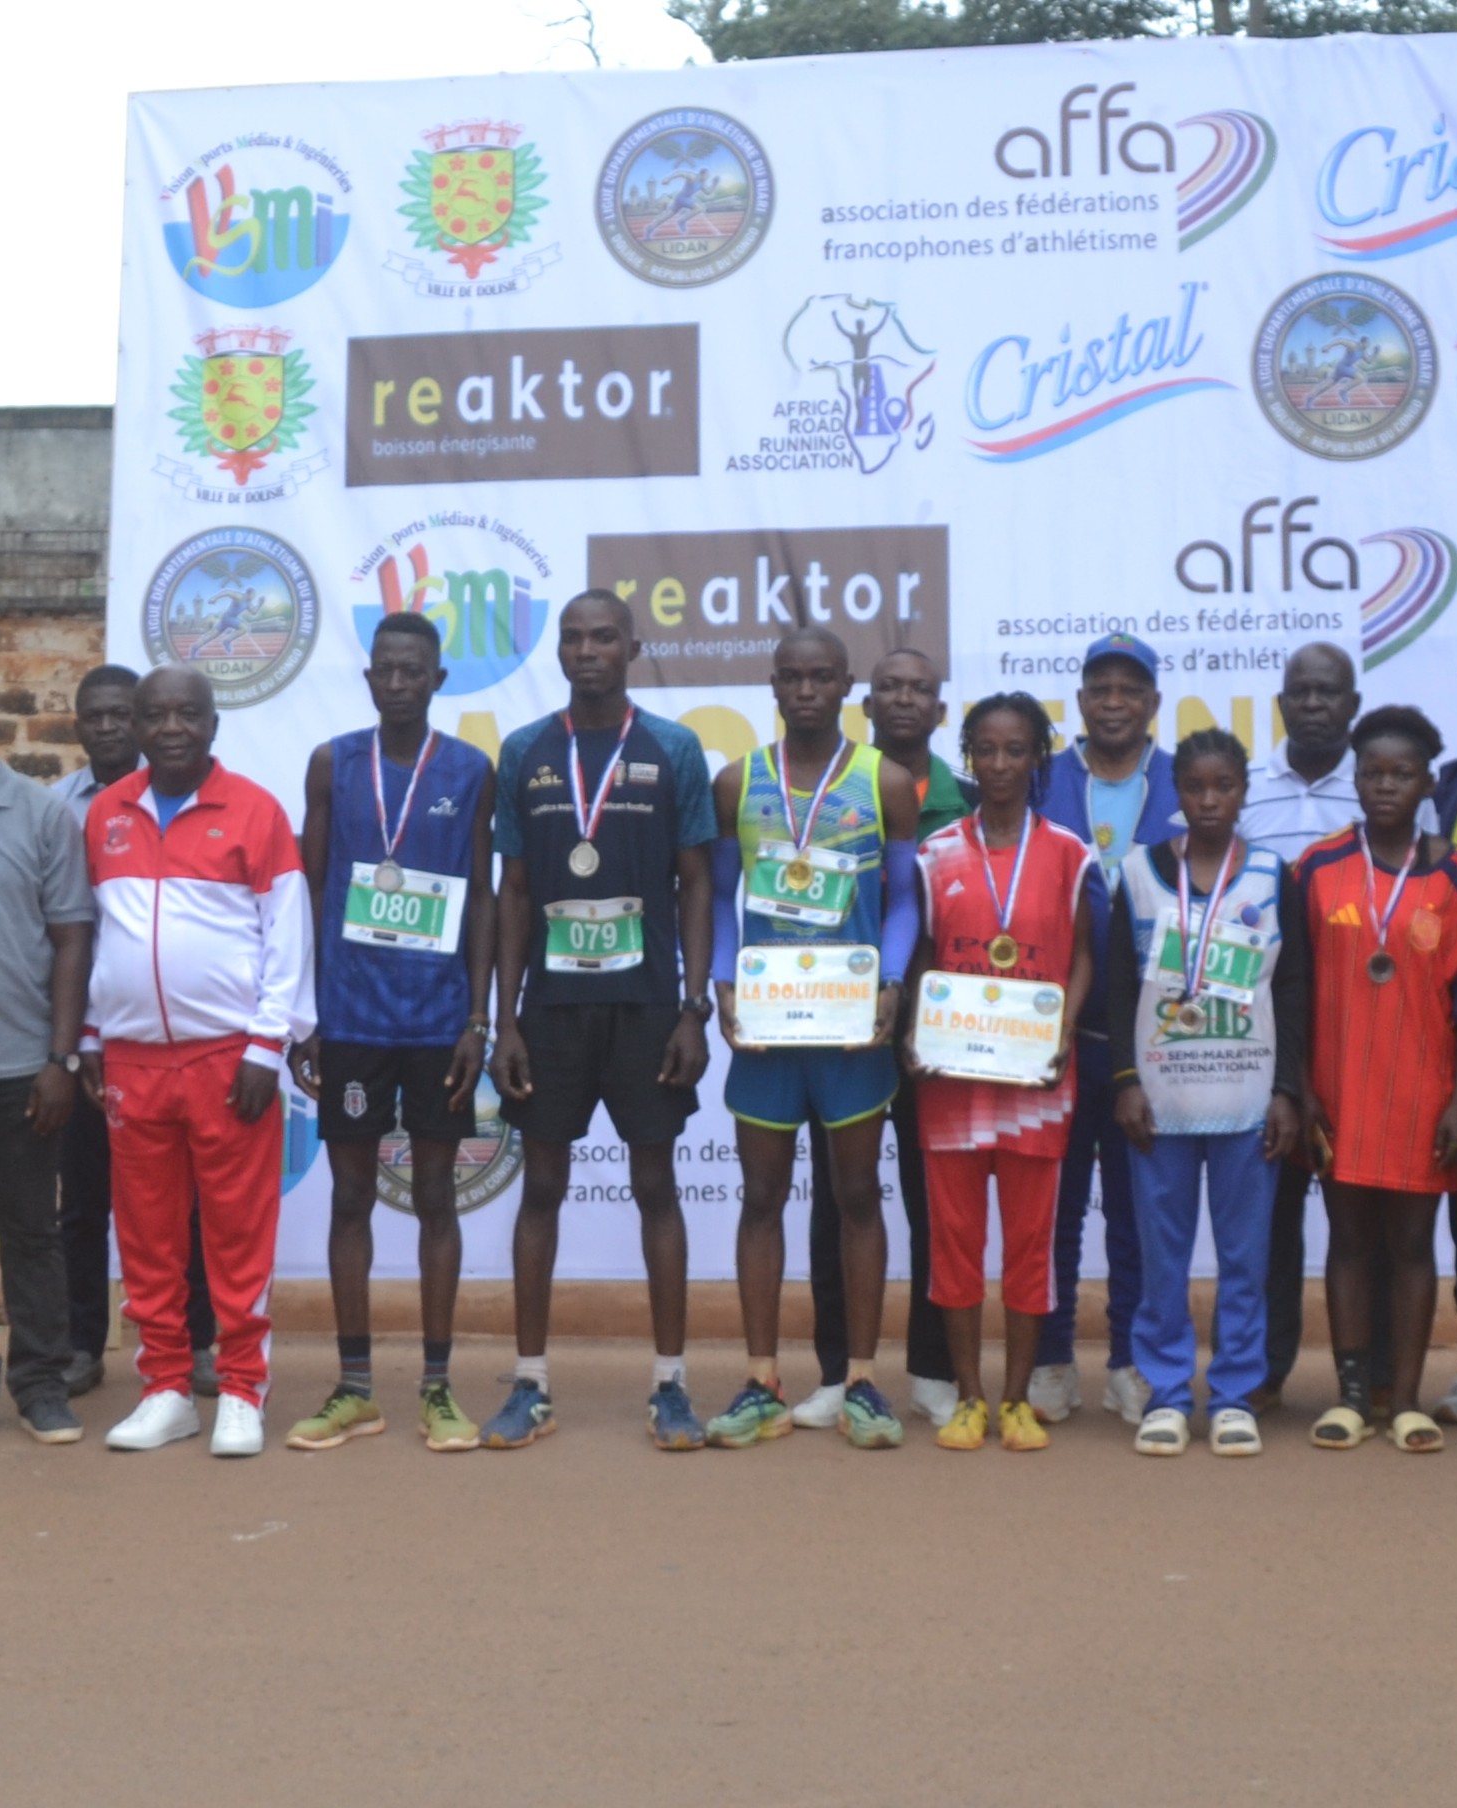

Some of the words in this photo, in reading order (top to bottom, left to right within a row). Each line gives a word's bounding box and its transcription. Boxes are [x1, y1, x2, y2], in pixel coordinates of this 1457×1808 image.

[996, 82, 1175, 180] affa
[752, 160, 766, 177] DU
[601, 188, 615, 219] LIGUE
[756, 179, 770, 212] NIARI
[822, 198, 958, 224] association
[966, 194, 1009, 218] des
[1016, 190, 1160, 216] fédérations
[661, 242, 709, 254] LIDAN
[824, 235, 994, 263] francophones
[1001, 230, 1159, 255] d'athlétisme
[427, 283, 455, 298] VILLE
[459, 286, 473, 298] DE
[1414, 329, 1429, 347] DU
[965, 281, 1203, 430] Cristal
[1258, 354, 1272, 387] LIGUE
[1418, 349, 1433, 384] NIARI
[373, 355, 671, 425] reaktor
[773, 400, 843, 419] AFRICA
[1322, 412, 1372, 425] LIDAN
[788, 417, 844, 434] ROAD
[372, 436, 435, 456] boisson
[440, 432, 536, 457] énergisante
[759, 435, 845, 453] RUNNING
[726, 452, 853, 472] ASSOCIATION
[196, 487, 224, 503] VILLE
[228, 491, 241, 504] DE
[1175, 496, 1359, 594] affa
[350, 545, 386, 583] Vision
[297, 580, 311, 597] DU
[147, 606, 161, 637] LIGUE
[301, 599, 315, 634] NIARI
[997, 611, 1137, 637] association
[1146, 610, 1190, 633] des
[1198, 607, 1343, 631] fédérations
[640, 638, 680, 657] sson
[206, 661, 254, 674] LIDAN
[528, 774, 563, 789] AGL
[775, 864, 826, 900] 08
[370, 891, 421, 926] 080
[570, 921, 617, 951] 079
[742, 982, 761, 1000] LA
[767, 981, 871, 1000] DOLISIENNE
[923, 1008, 943, 1026] LA
[950, 1011, 1055, 1041] DOLISIENNE
[470, 1186, 486, 1200] DU
[486, 1155, 516, 1189] CONGO
